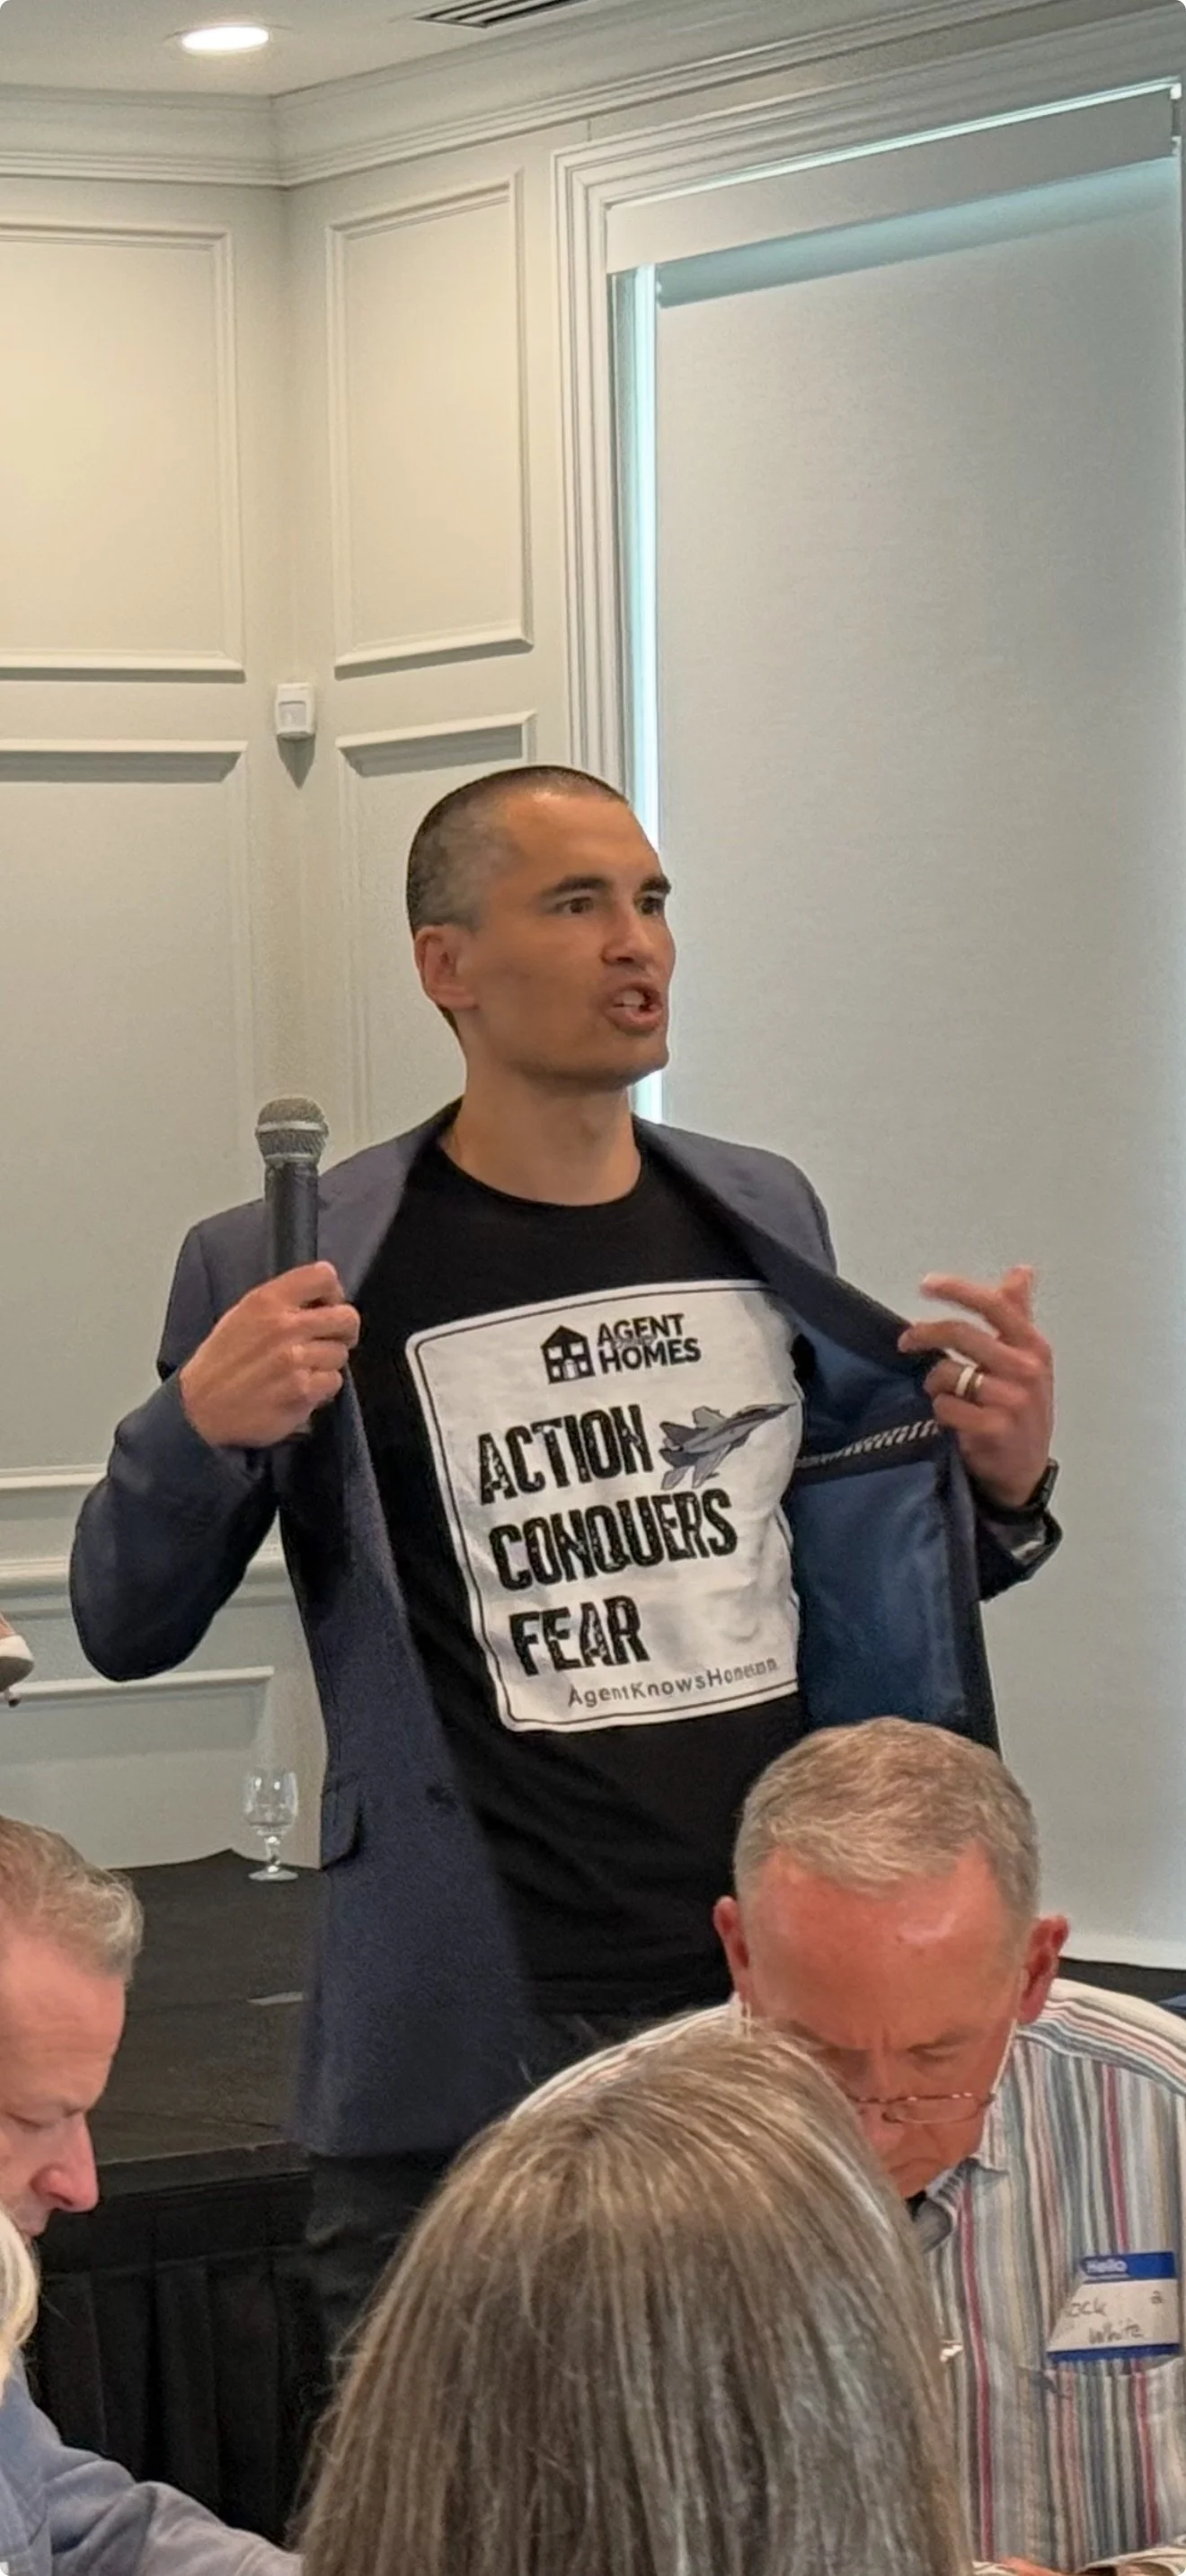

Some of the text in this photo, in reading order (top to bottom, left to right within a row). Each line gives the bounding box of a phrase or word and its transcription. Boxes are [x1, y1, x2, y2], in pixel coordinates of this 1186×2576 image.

[597, 1312, 685, 1347] AGENT
[597, 1337, 702, 1374] HOMES
[477, 1403, 654, 1505] ACTION
[488, 1488, 738, 1591] CONQUERS
[509, 1595, 650, 1676] FEAR
